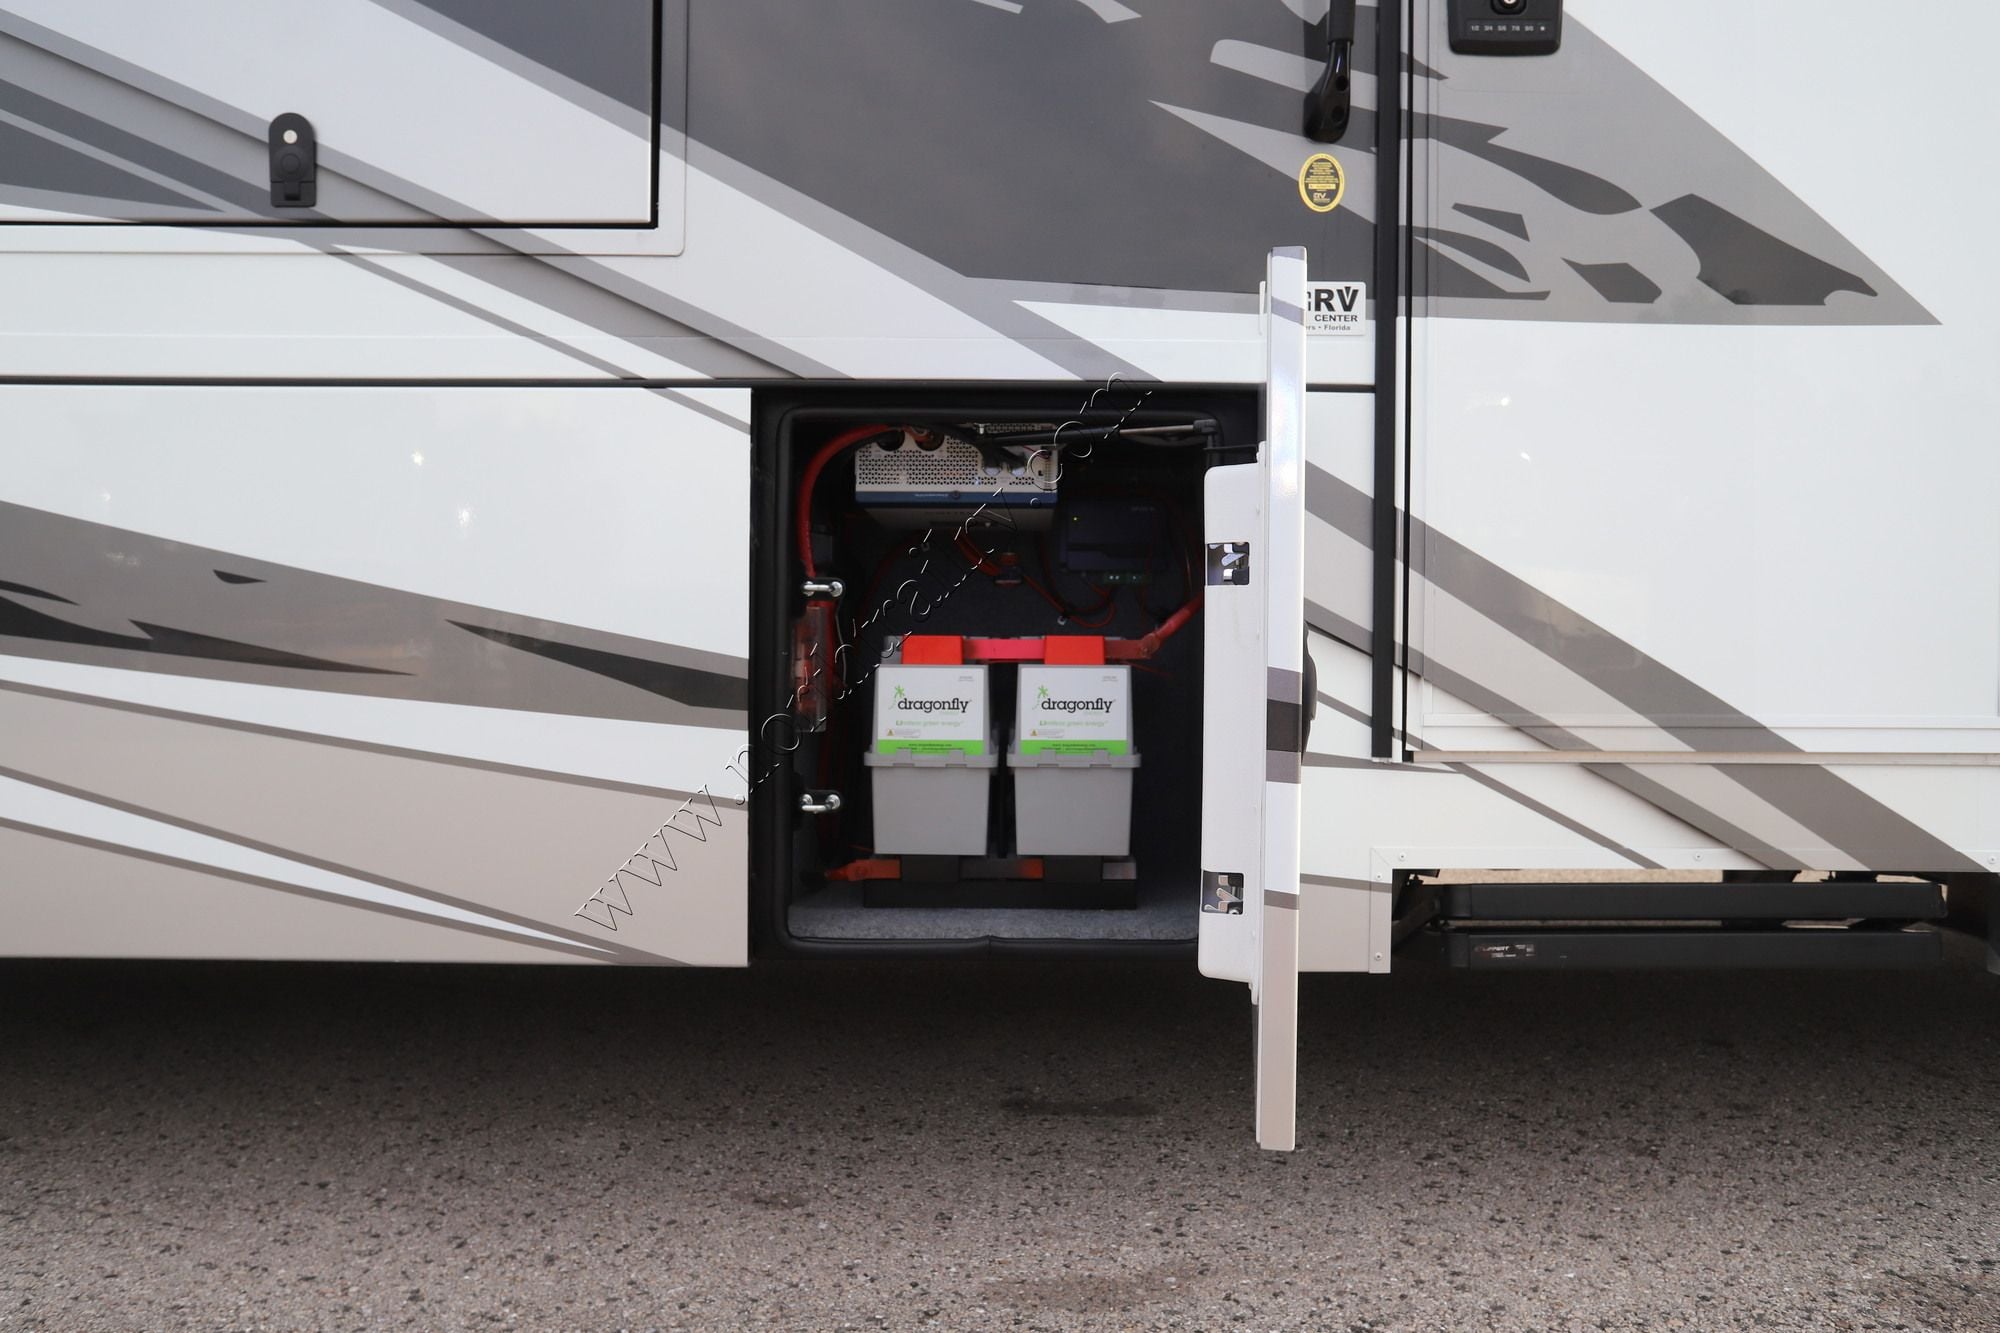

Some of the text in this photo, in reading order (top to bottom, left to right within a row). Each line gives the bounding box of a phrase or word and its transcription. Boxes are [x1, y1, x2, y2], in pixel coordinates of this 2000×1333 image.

[1314, 286, 1359, 312] RV
[1314, 314, 1358, 322] CENTER
[897, 697, 969, 714] dragonfly
[1041, 697, 1113, 714] dragonfly
